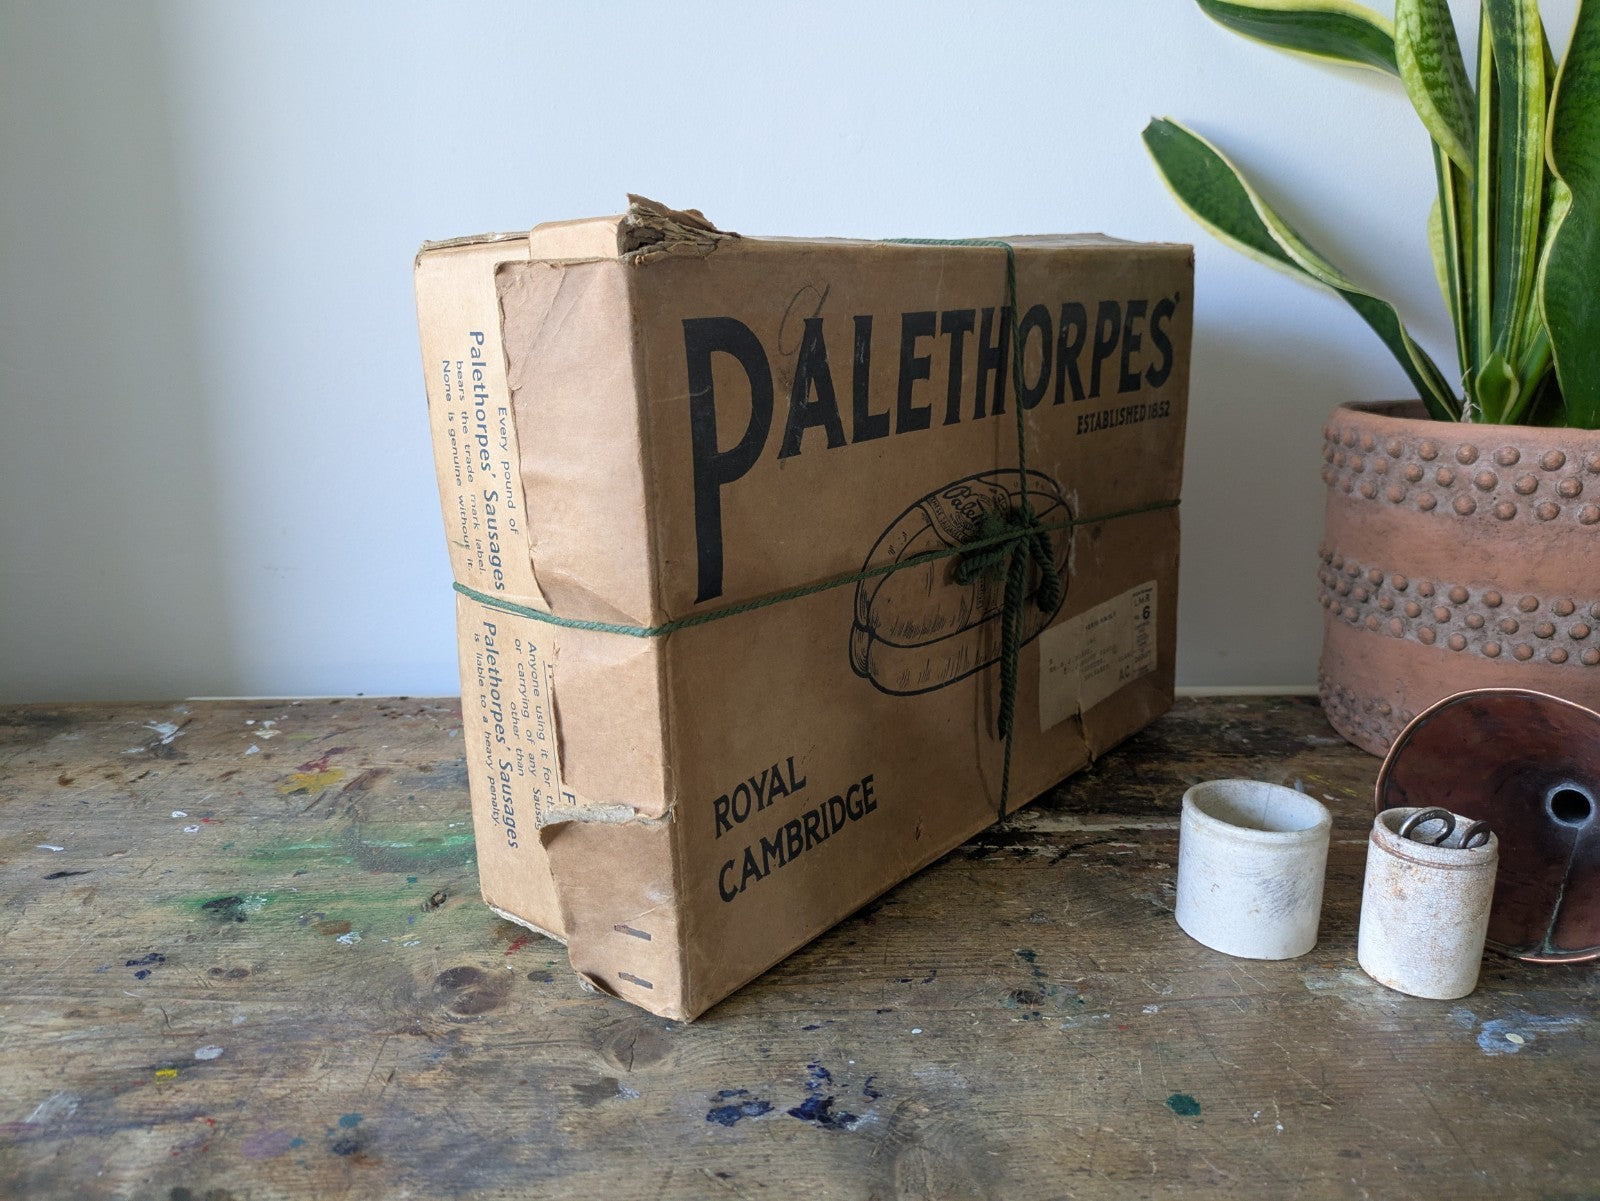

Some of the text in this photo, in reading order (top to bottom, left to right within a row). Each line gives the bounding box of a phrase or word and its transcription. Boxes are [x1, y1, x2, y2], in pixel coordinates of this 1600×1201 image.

[443, 360, 452, 401] None
[448, 412, 455, 422] is
[1076, 399, 1171, 435] ESTABLISHED 1852
[448, 428, 461, 486] genuine
[456, 360, 486, 574] bears the trade mark label.
[498, 407, 519, 535] Every pound of
[458, 495, 470, 550] without
[484, 490, 505, 590] Sausages
[1142, 605, 1151, 620] 6
[474, 632, 480, 643] is
[515, 638, 521, 654] or
[476, 652, 485, 687] liable
[528, 641, 540, 697] Anyone
[480, 694, 487, 708] to
[517, 663, 530, 718] carrying
[510, 702, 524, 776] other than
[526, 729, 535, 745] of
[536, 705, 545, 740] using
[484, 731, 494, 770] heavy
[528, 753, 537, 777] any
[541, 749, 548, 759] it
[543, 766, 551, 787] for
[487, 776, 500, 826] penalty.
[498, 759, 518, 848] Sausages
[713, 755, 807, 840] ROYAL
[718, 773, 878, 903] CAMBRIDGE
